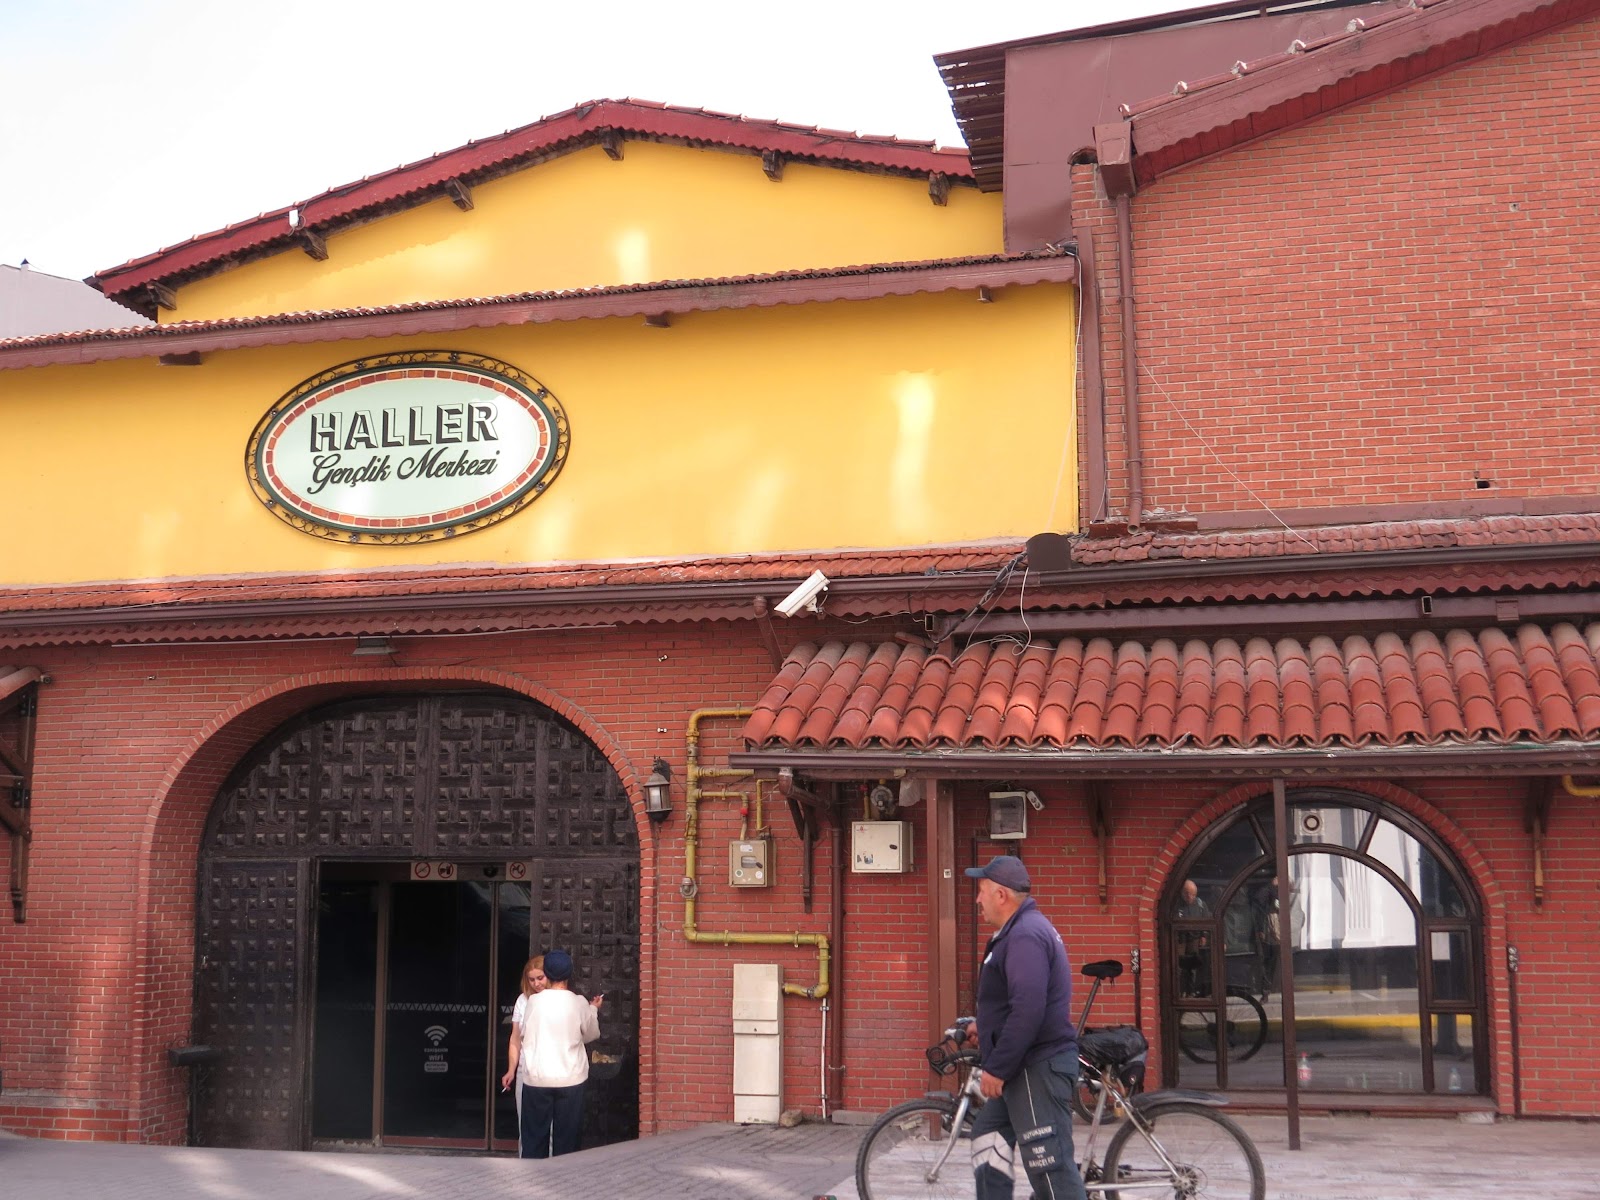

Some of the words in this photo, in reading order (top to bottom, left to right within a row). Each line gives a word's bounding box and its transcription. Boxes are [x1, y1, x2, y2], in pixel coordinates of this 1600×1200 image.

[310, 402, 499, 452] HALLER
[307, 453, 391, 495] Gençlik
[396, 447, 500, 480] Merkezi
